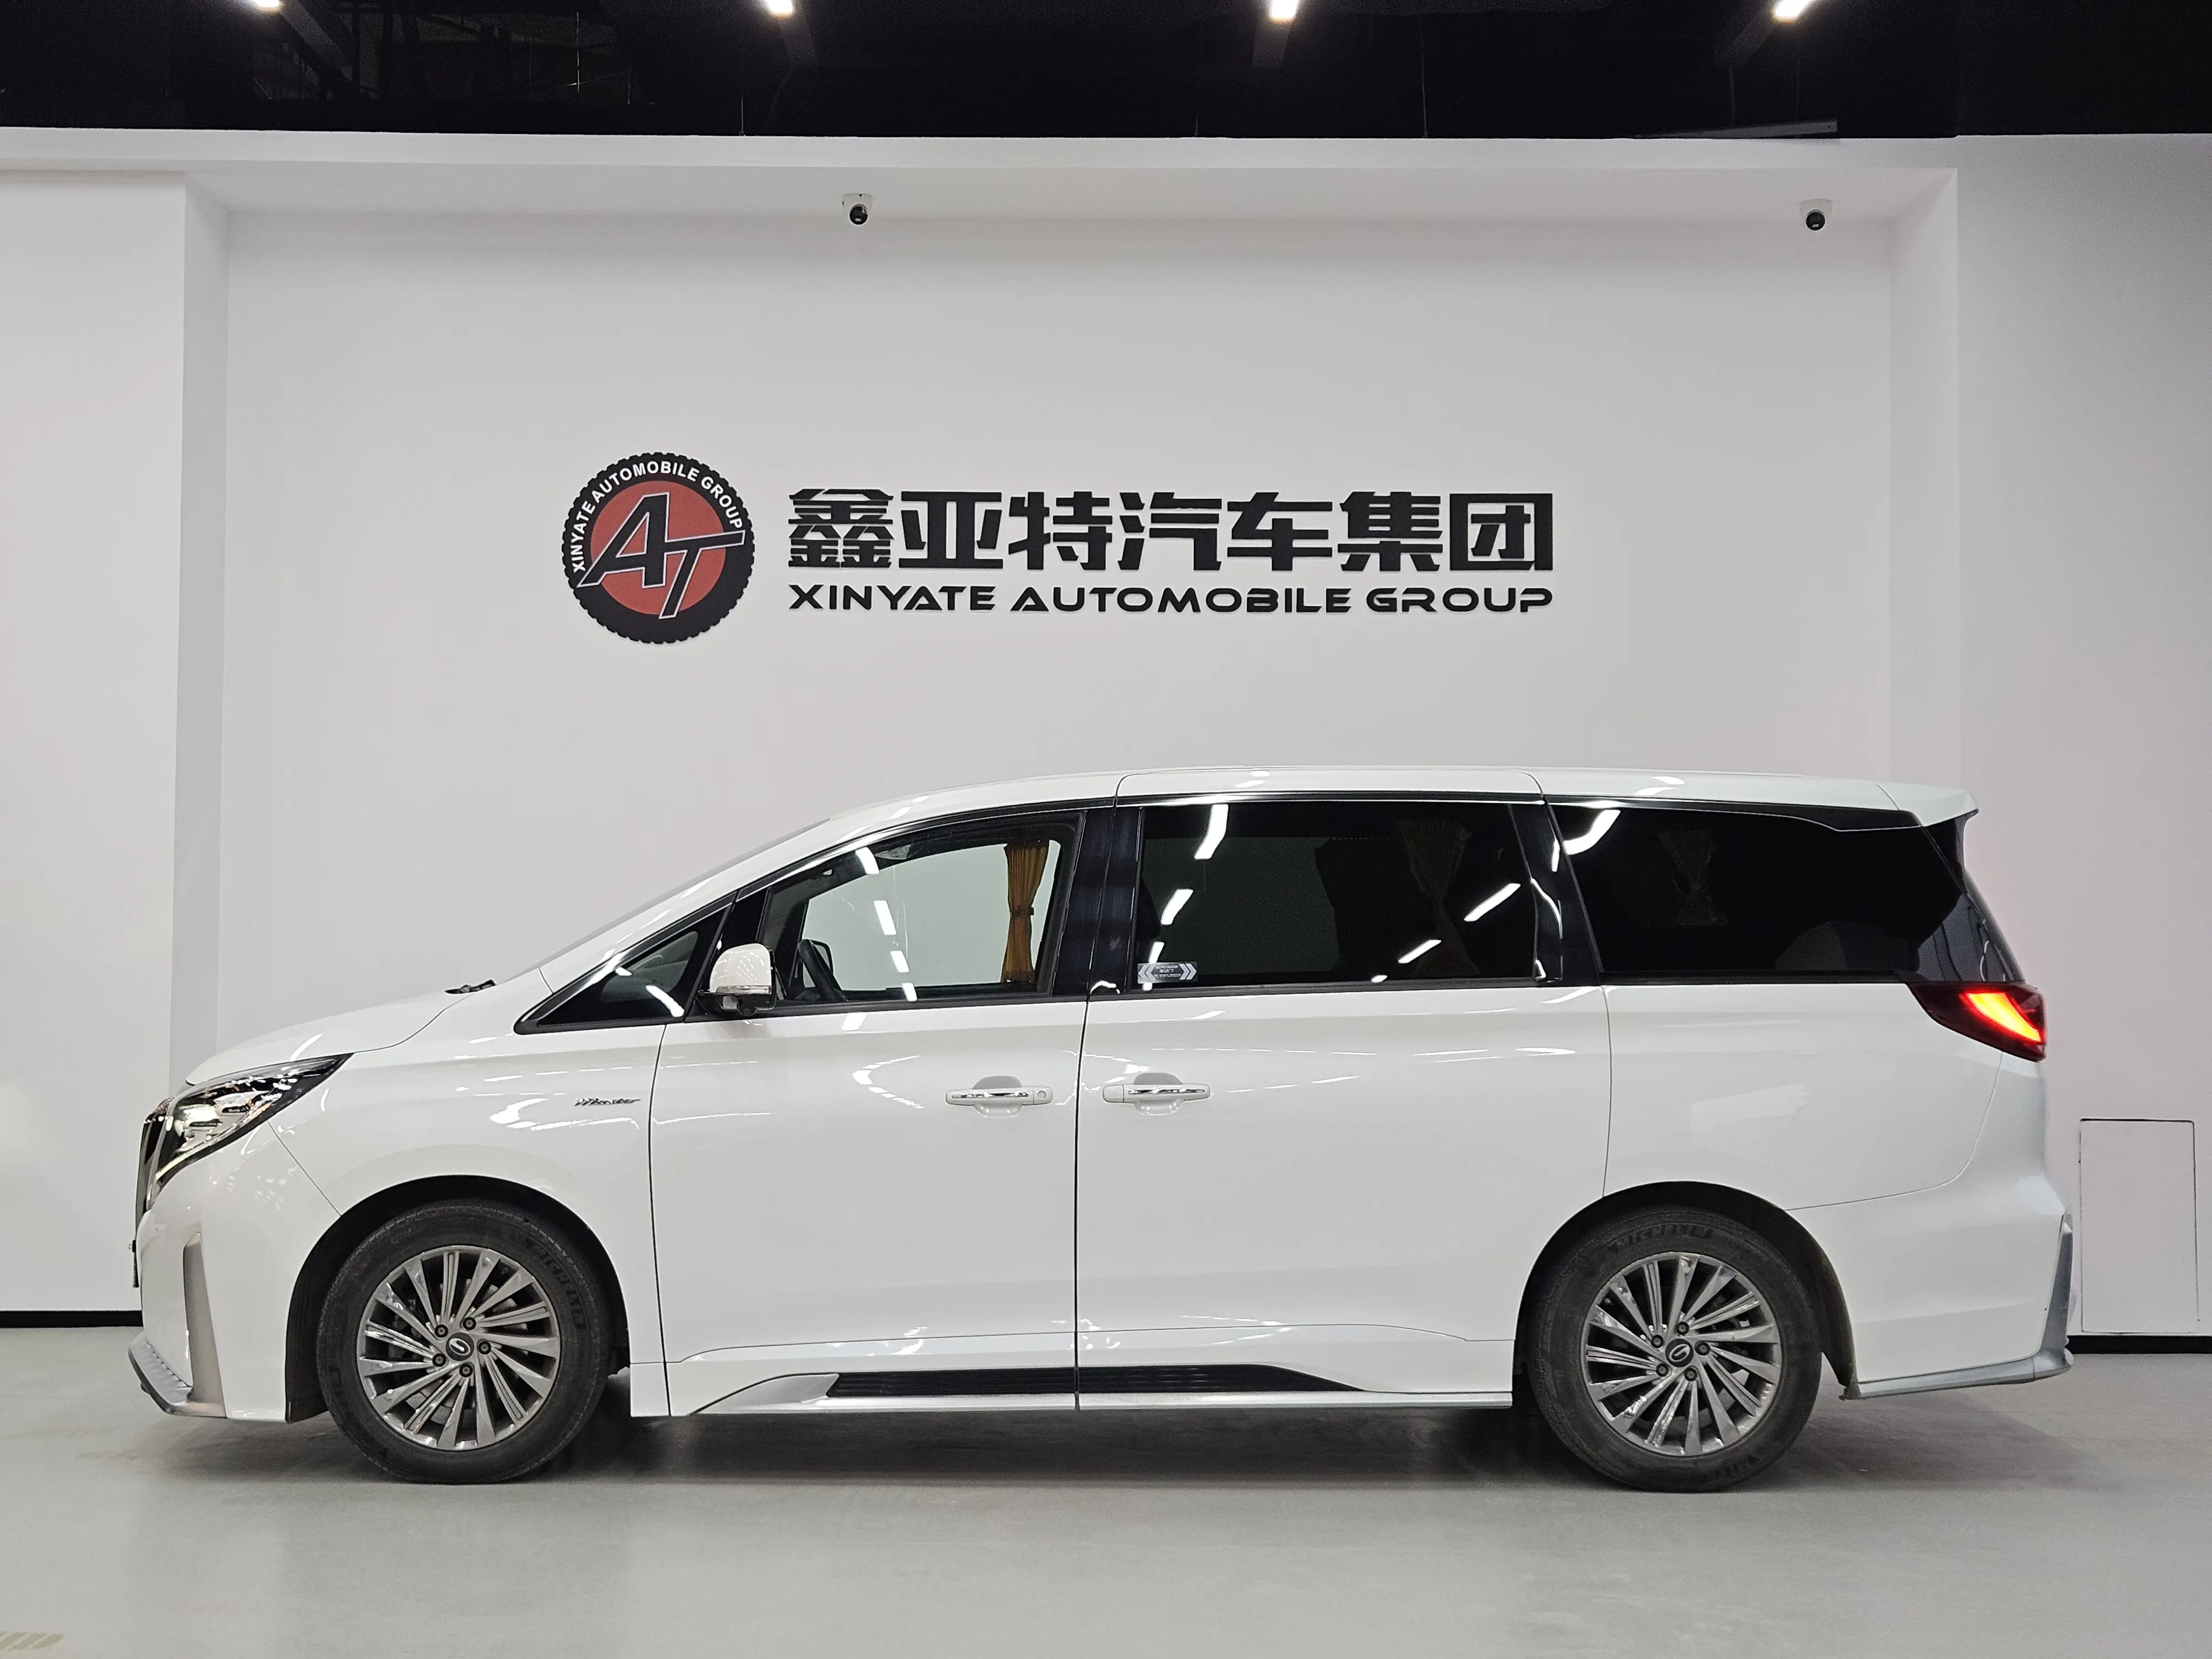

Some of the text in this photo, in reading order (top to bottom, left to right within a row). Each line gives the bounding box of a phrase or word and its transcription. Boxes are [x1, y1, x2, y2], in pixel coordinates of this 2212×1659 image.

[570, 460, 743, 573] XINYATE AUTOMOBILE GROUP
[788, 488, 1553, 572] 鑫亚特汽车集团
[789, 584, 1553, 613] XINYATE AUTOMOBILE GROUP
